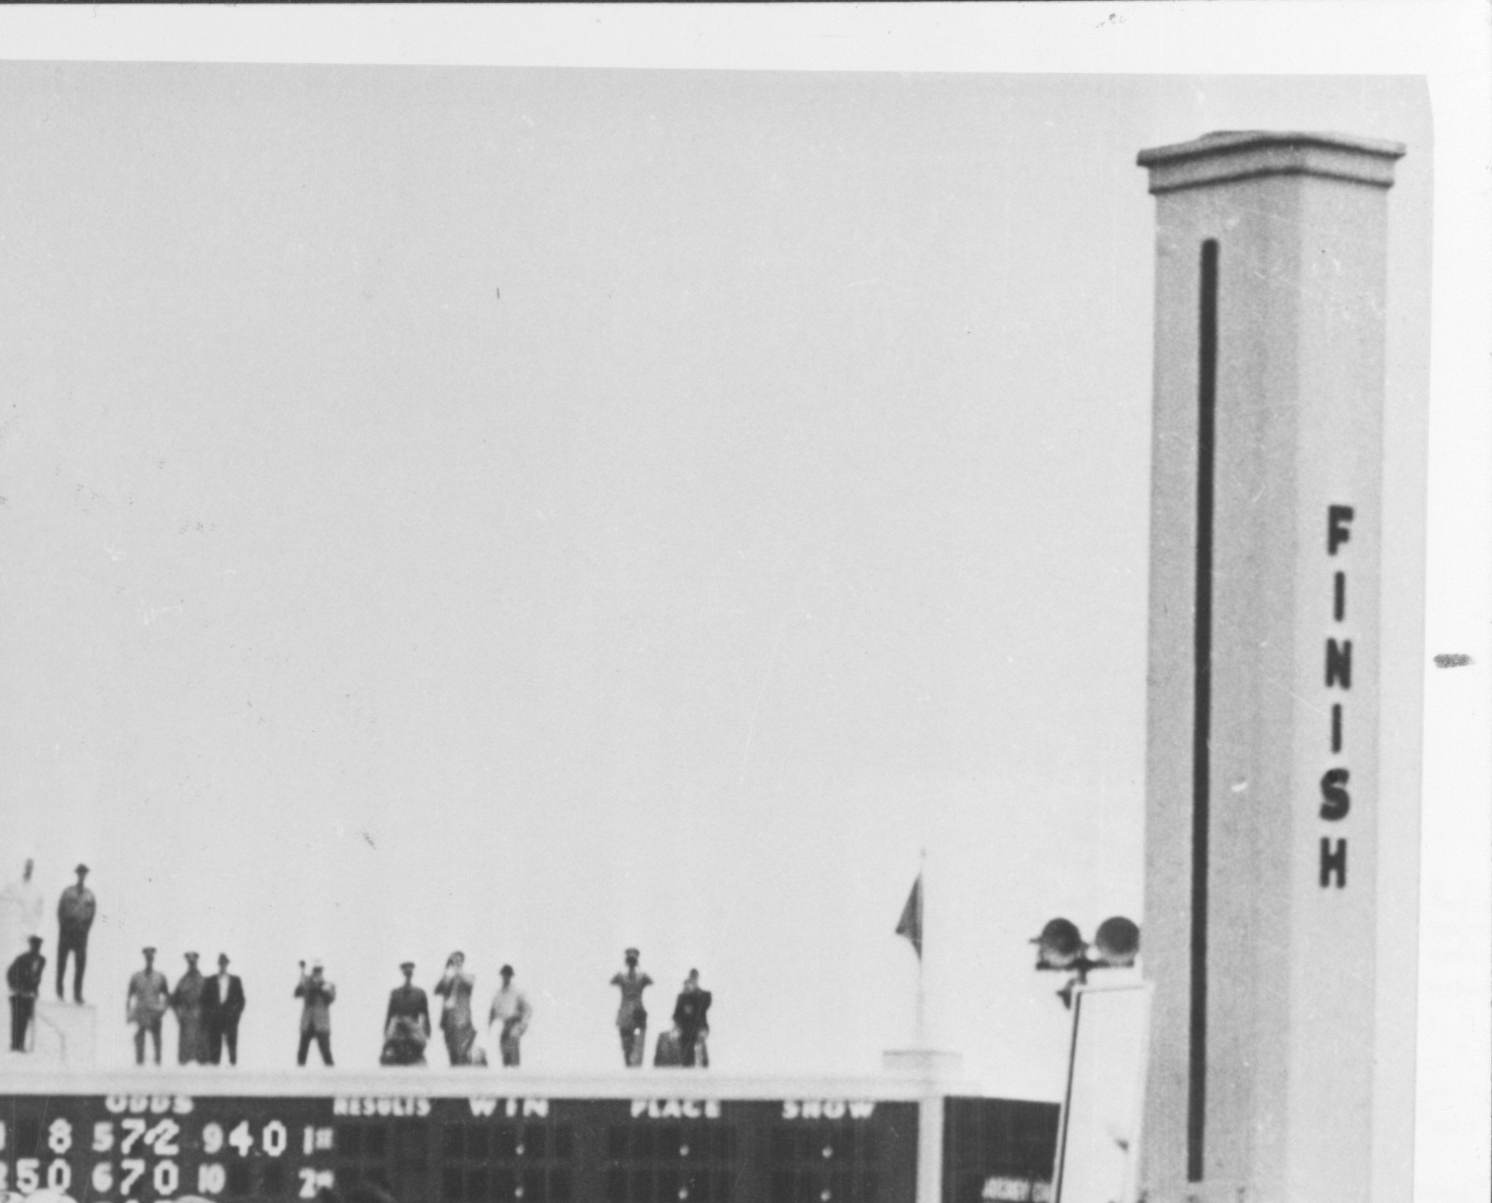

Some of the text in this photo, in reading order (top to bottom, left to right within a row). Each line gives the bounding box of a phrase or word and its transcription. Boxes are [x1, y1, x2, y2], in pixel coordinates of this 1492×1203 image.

[1318, 504, 1356, 889] FINISH
[104, 1094, 876, 1120] ODDS RESULTS WIN PLACE SHOW
[48, 1117, 73, 1155] 8
[92, 1121, 115, 1153] 5
[197, 1162, 227, 1195] 10
